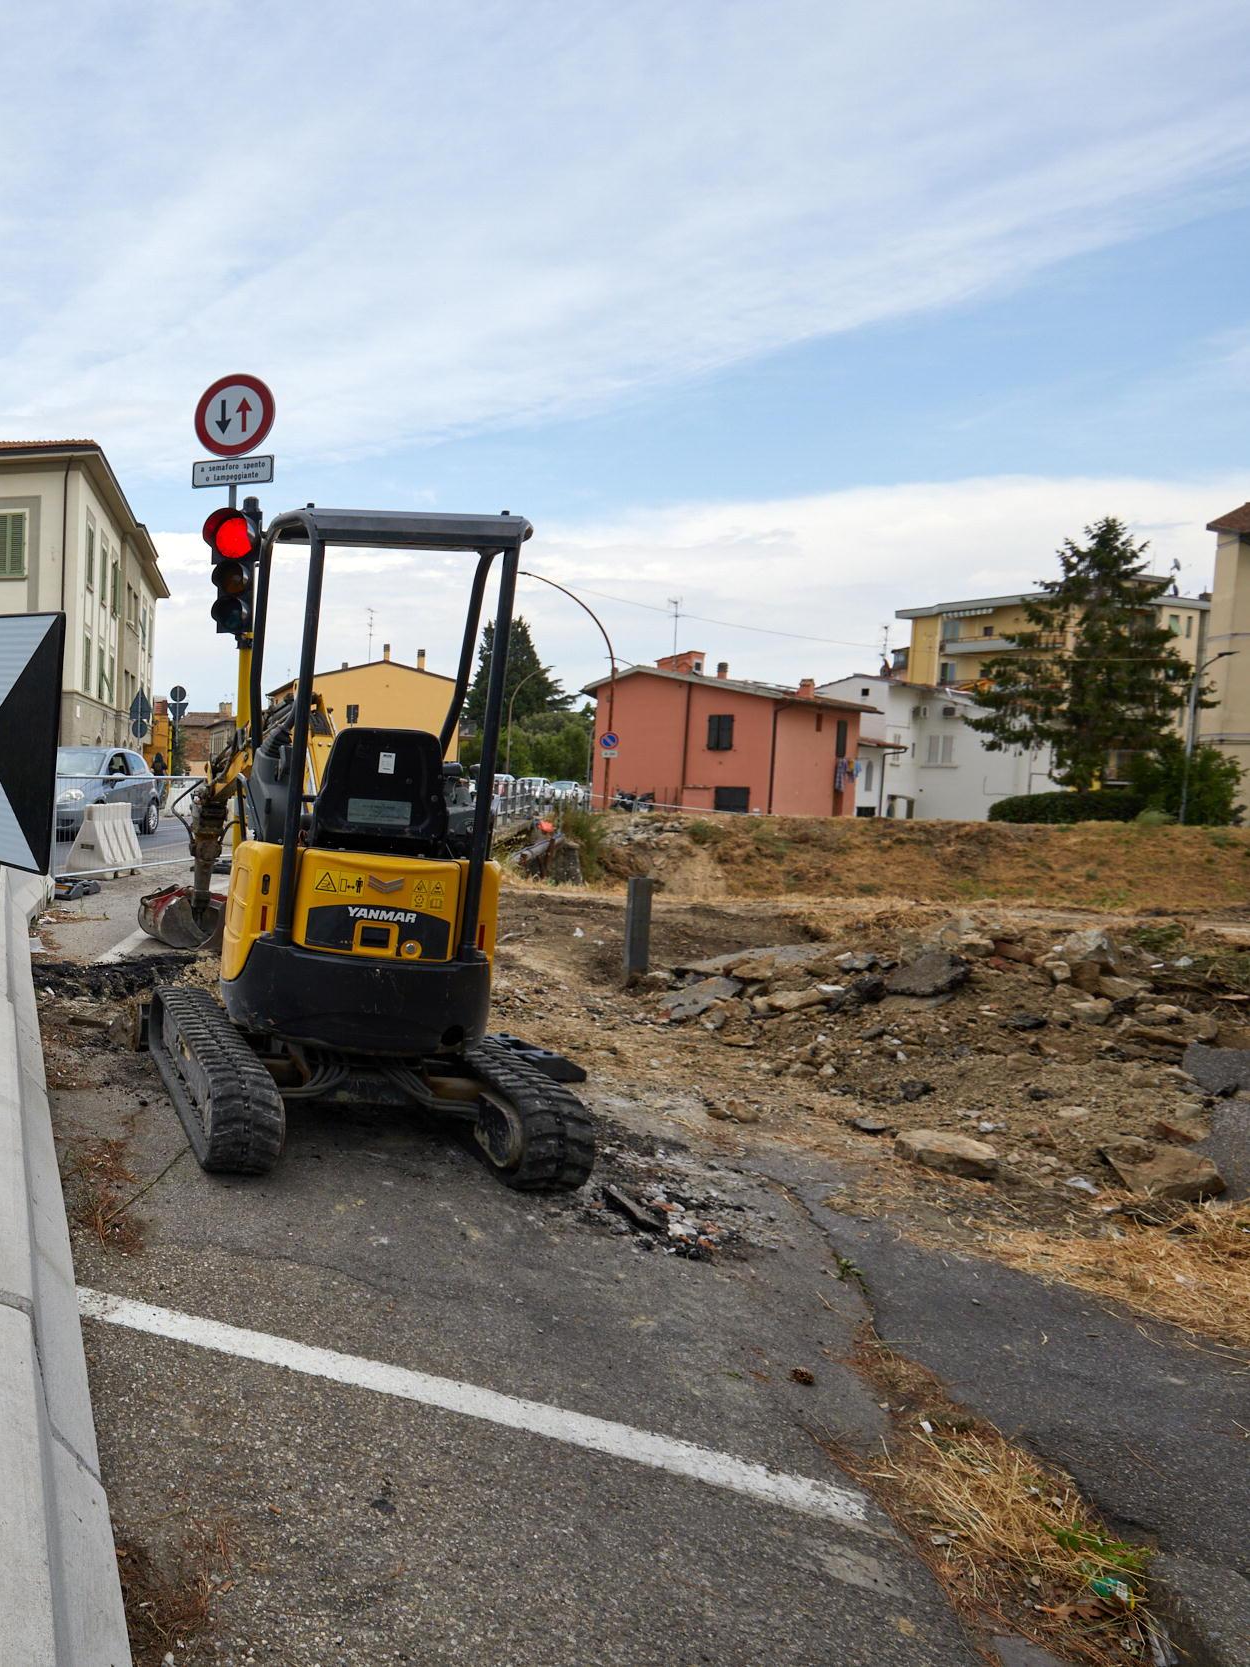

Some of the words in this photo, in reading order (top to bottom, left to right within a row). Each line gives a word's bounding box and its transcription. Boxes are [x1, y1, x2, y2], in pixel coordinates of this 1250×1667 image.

[209, 463, 239, 472] semaforo
[243, 460, 266, 469] spento
[214, 471, 259, 481] lampeggiante
[347, 906, 417, 923] YANMAR
